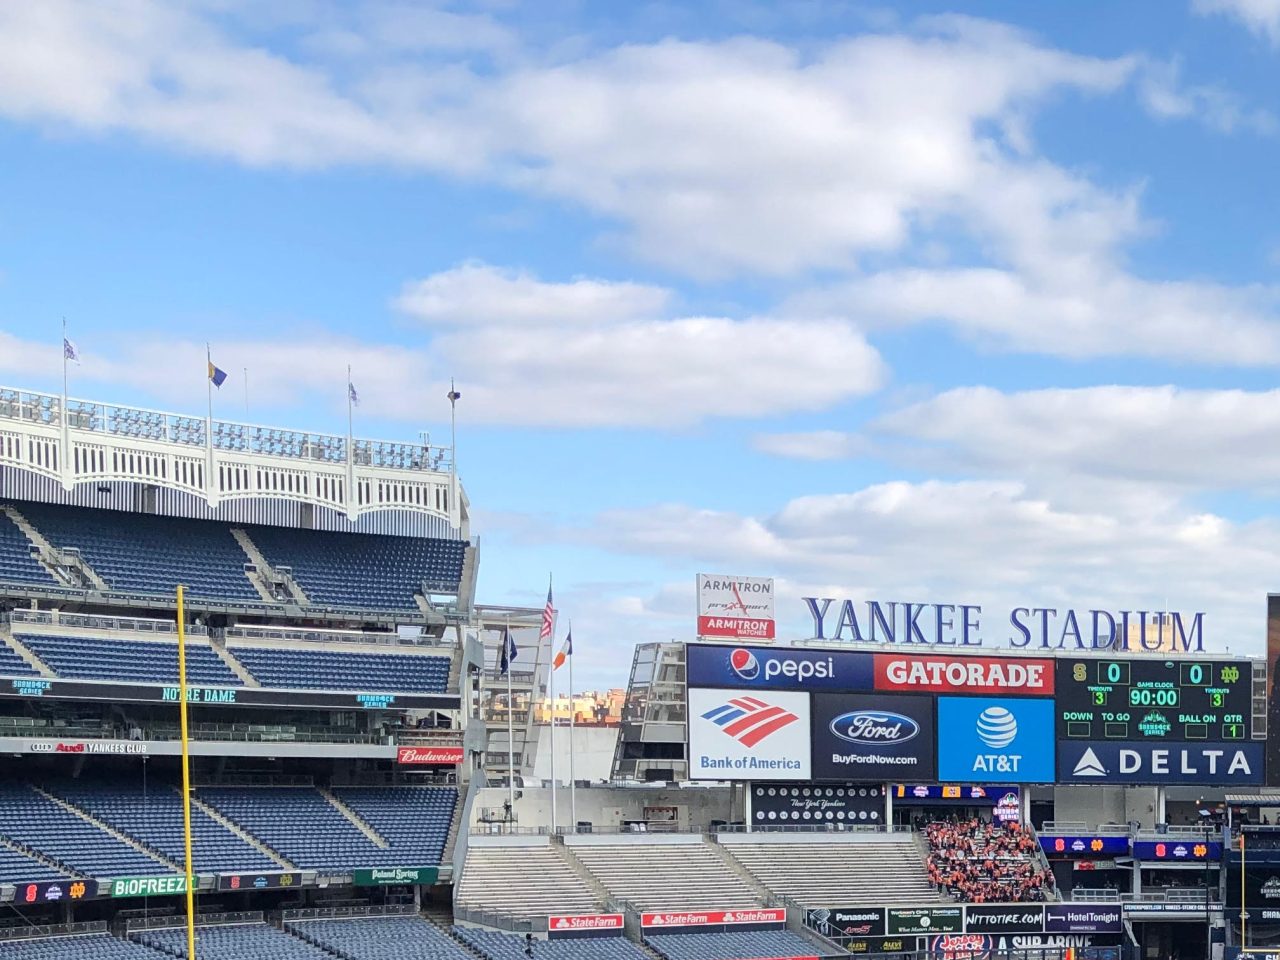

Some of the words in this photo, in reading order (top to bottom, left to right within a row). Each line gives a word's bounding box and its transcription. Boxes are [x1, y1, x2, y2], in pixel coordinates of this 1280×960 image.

[703, 580, 770, 594] ARMITRON
[707, 619, 768, 630] ARMITRON
[801, 597, 983, 647] YANKEE
[1009, 607, 1207, 652] STADIUM
[765, 657, 834, 682] pepsi
[886, 661, 1044, 688] GATORADE
[1107, 663, 1121, 683] 0
[1189, 665, 1203, 684] 0
[205, 690, 236, 703] DAME
[1095, 692, 1104, 704] 3
[1130, 690, 1177, 705] 90:00
[1213, 694, 1221, 706] 3
[1063, 712, 1093, 721] DOWN
[1101, 712, 1115, 721] TO
[1116, 712, 1131, 721] GO
[1179, 715, 1201, 723] BALL
[1202, 715, 1216, 723] ON
[1224, 715, 1242, 723] QTR
[848, 715, 901, 739] Ford
[1229, 724, 1237, 737] 1
[56, 743, 85, 752] Audi
[87, 743, 124, 753] YANKEES
[127, 744, 147, 752] CLUB
[400, 749, 462, 763] Budweiser
[832, 754, 917, 766] BuyFordNow.com
[1119, 749, 1251, 774] DELTA
[701, 756, 733, 769] Bank
[734, 756, 749, 769] of
[750, 757, 801, 770] America
[973, 755, 1022, 773] AT&T
[791, 798, 805, 807] New
[805, 799, 820, 809] York
[820, 799, 846, 809] Yankees
[372, 869, 395, 880] Poland
[396, 869, 418, 880] Spring
[836, 913, 880, 922] Panasonic
[966, 913, 1043, 925] NITTOTIRE.COM
[940, 934, 984, 948] Jersey
[998, 937, 1007, 955] A
